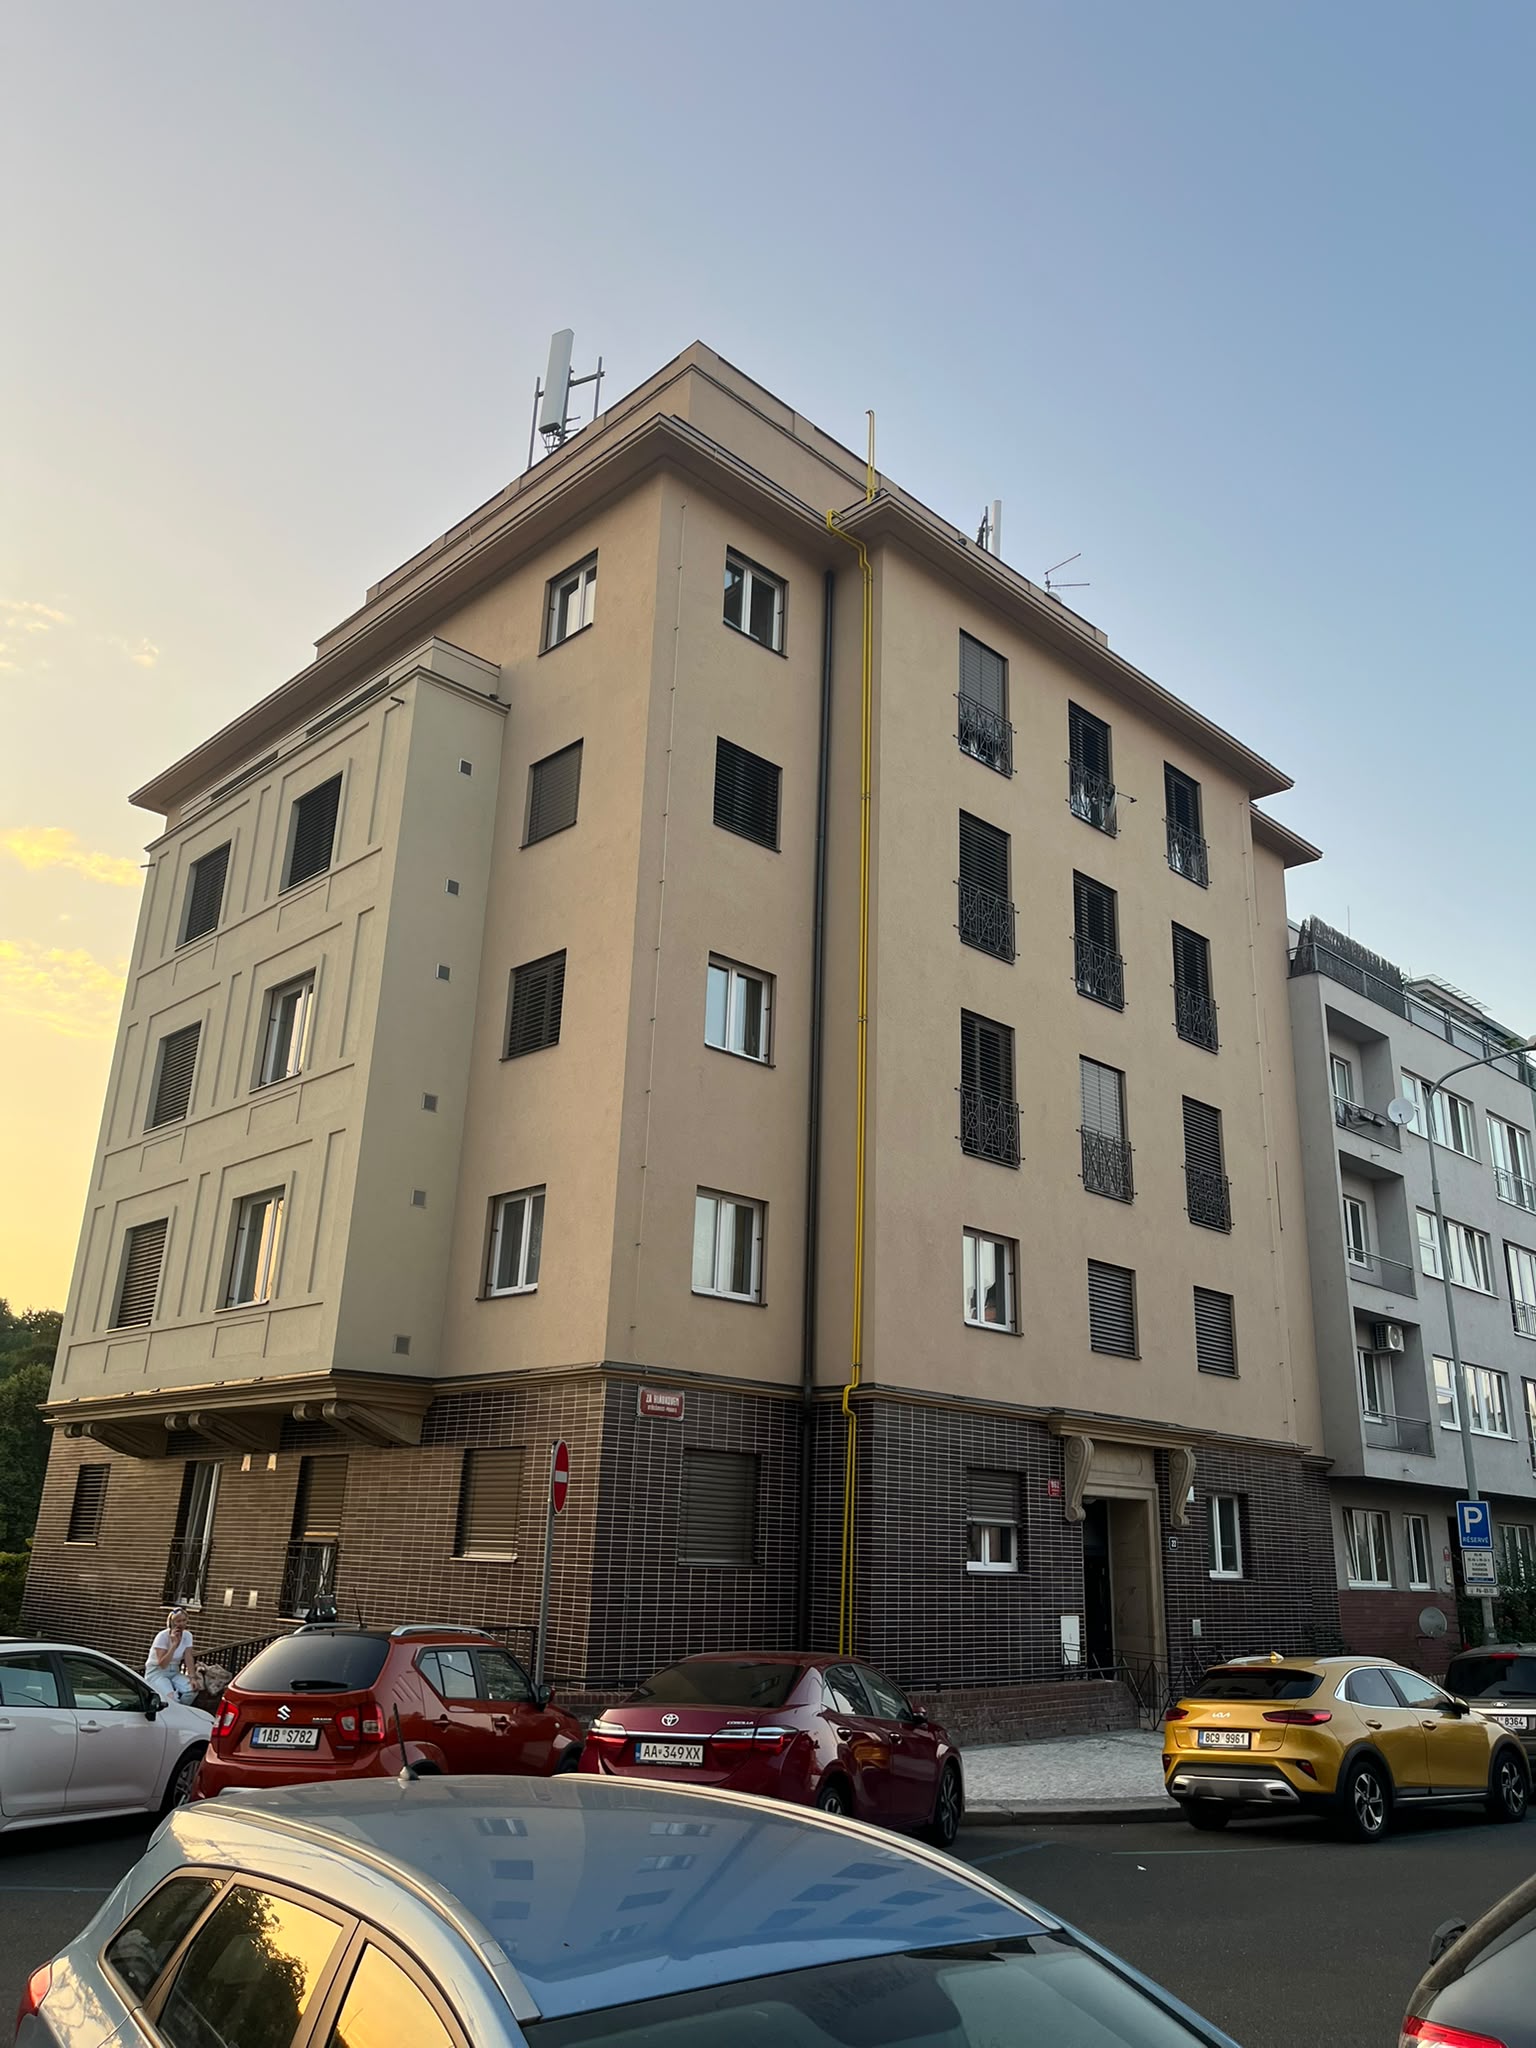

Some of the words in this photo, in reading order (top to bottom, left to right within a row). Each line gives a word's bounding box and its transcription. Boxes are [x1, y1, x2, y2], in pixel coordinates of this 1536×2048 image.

[1463, 1506, 1483, 1534] P
[262, 1729, 280, 1743] 1AB
[286, 1730, 313, 1744] S782
